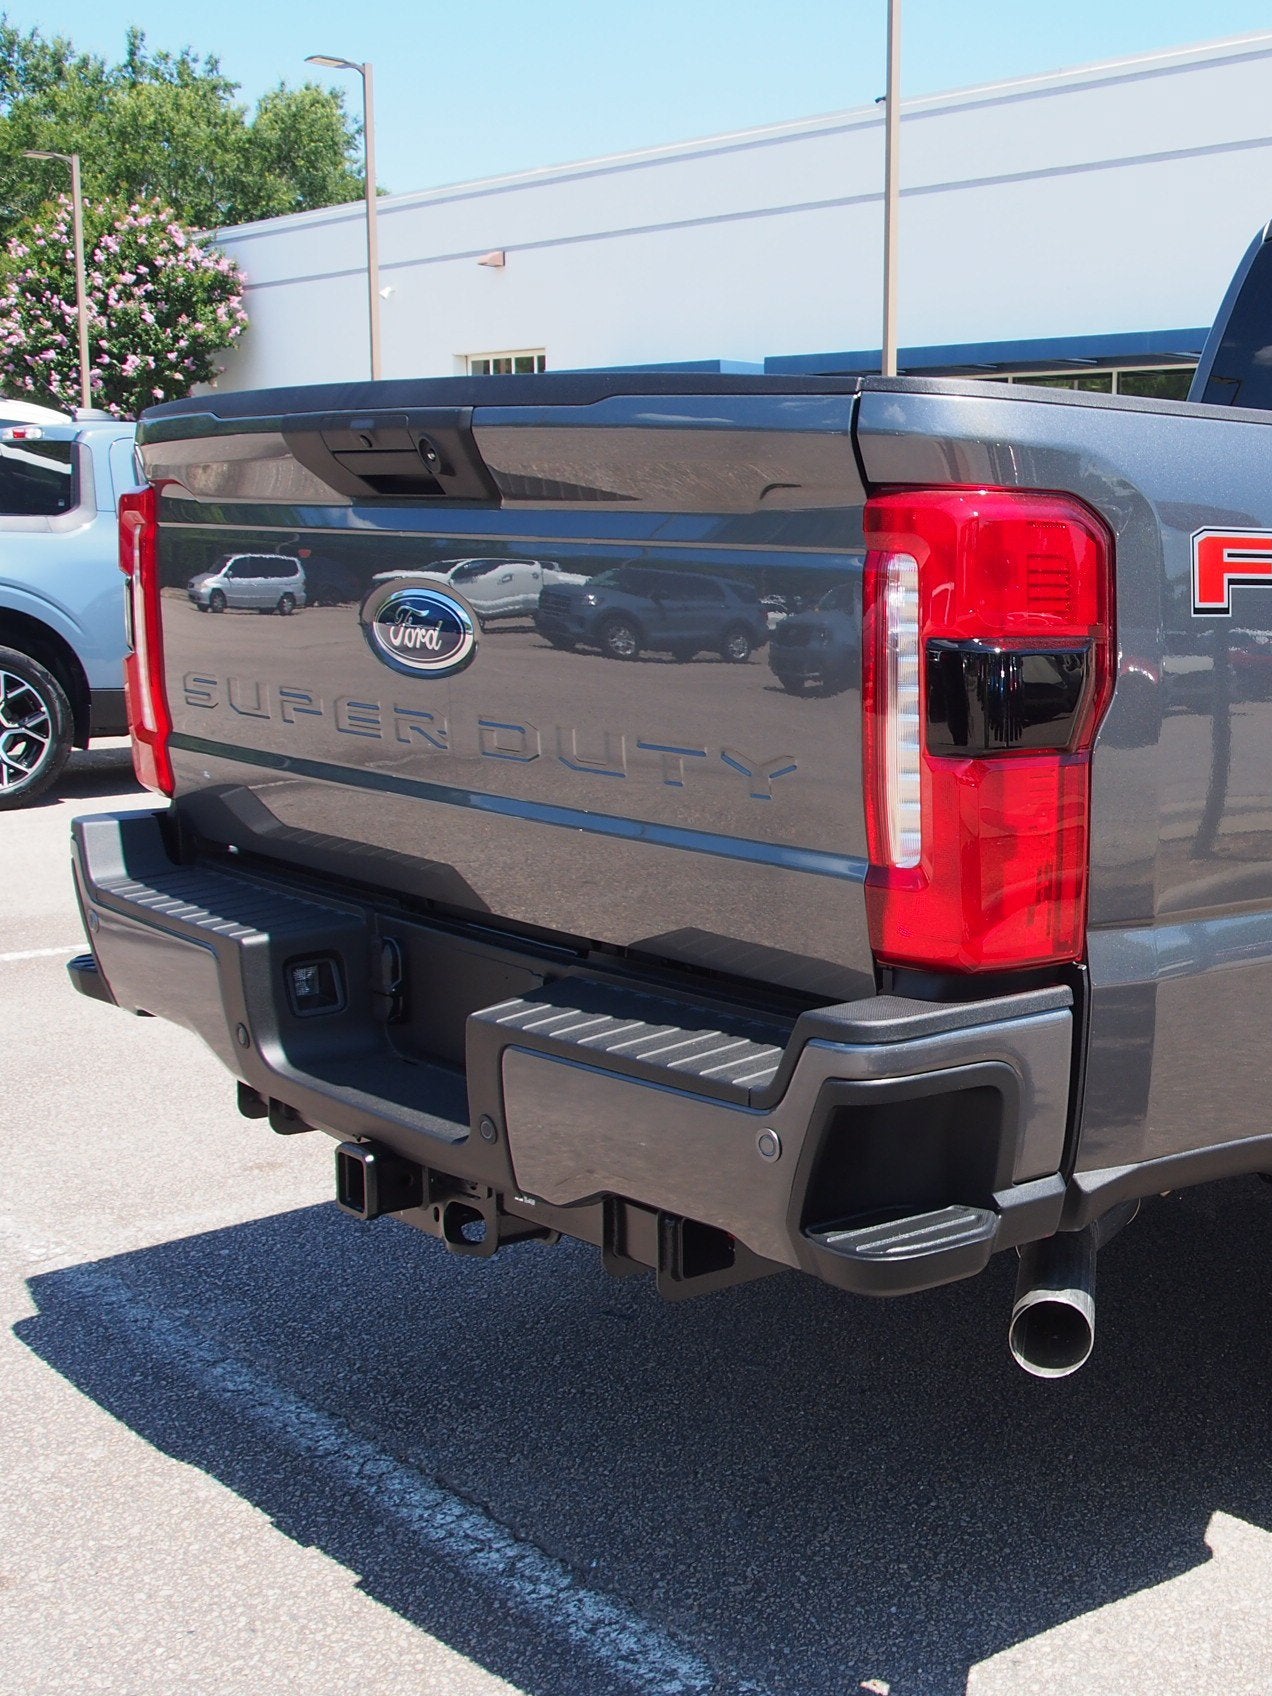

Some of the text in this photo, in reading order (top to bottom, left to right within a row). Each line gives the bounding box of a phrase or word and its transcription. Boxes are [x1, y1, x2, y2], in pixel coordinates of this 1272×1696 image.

[389, 605, 442, 651] Ford
[183, 669, 798, 801] SUPER DUTY
